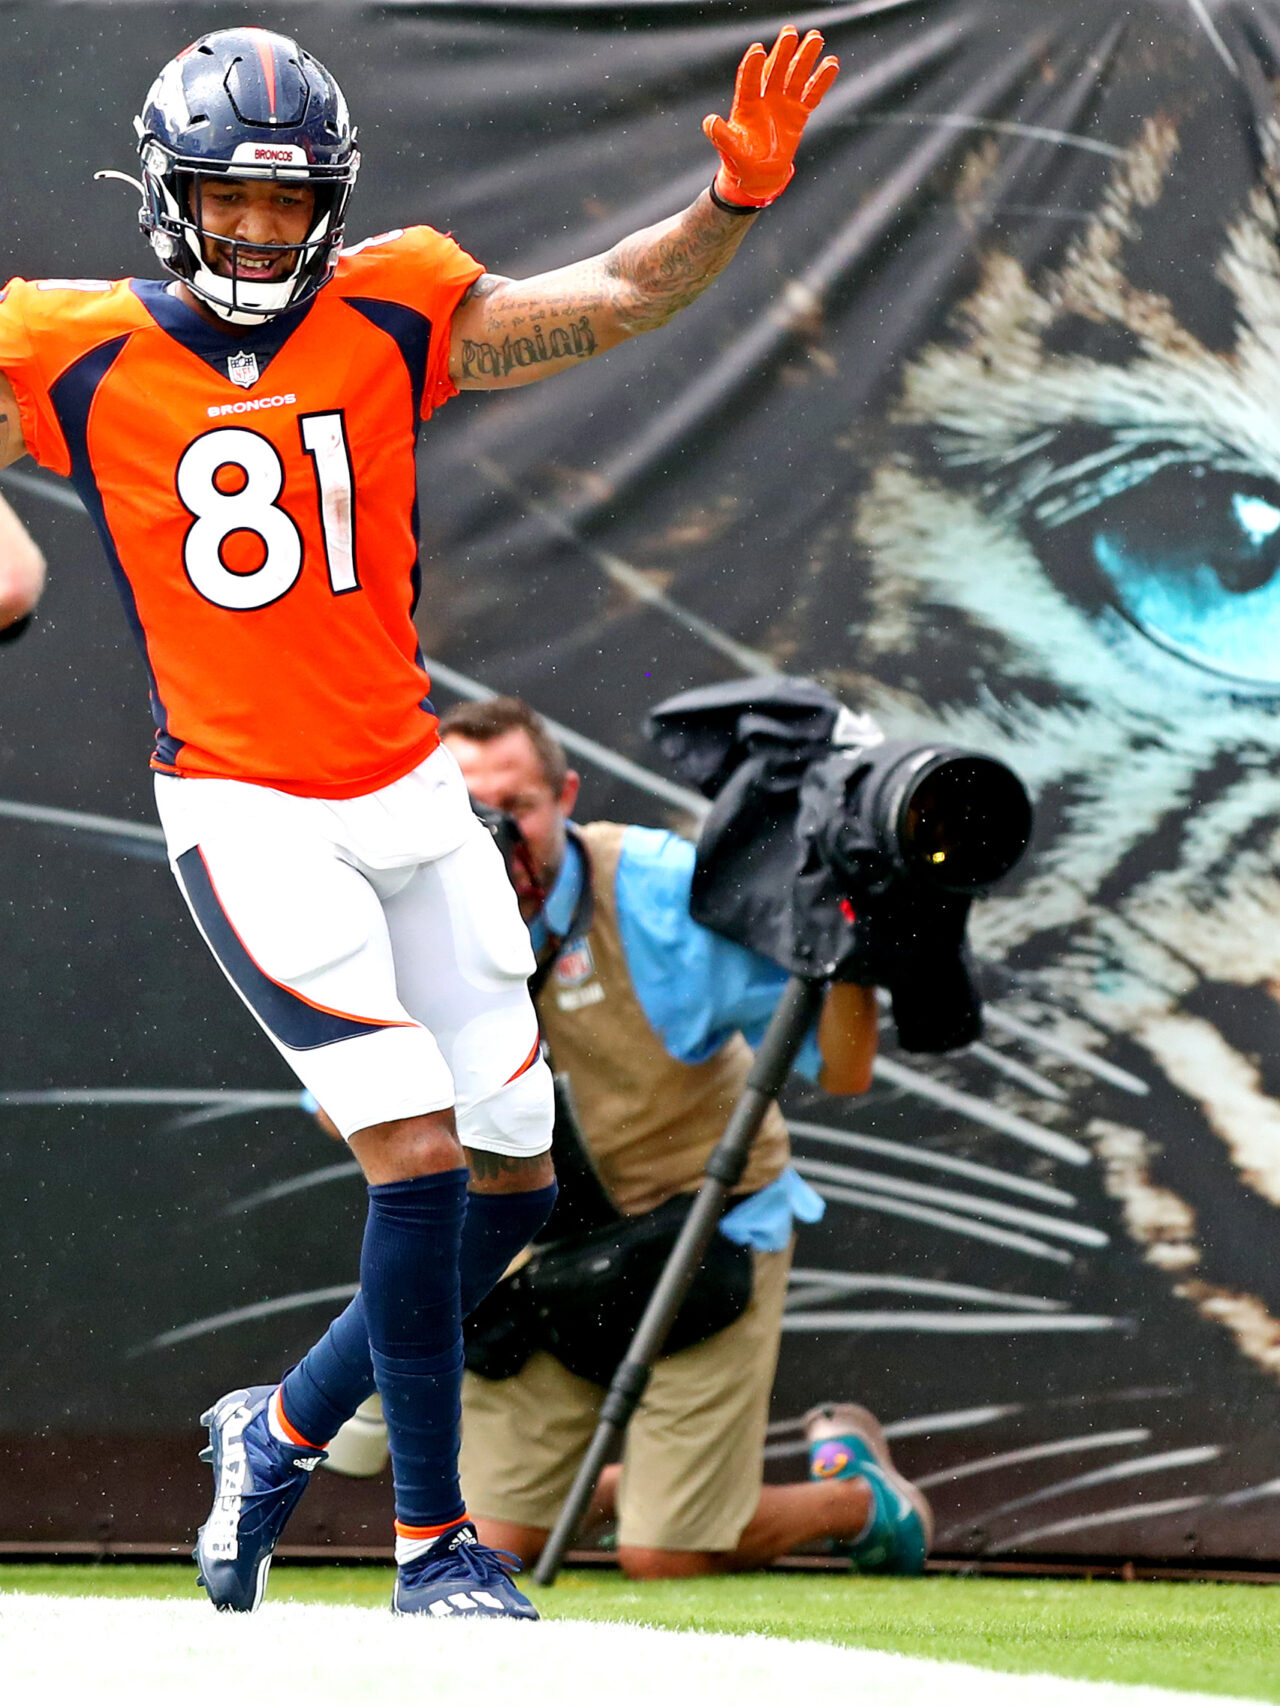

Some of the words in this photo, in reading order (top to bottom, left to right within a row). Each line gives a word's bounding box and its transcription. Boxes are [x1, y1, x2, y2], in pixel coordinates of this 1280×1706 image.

[254, 148, 293, 162] BRONCOS
[207, 393, 297, 418] BRONCOS
[175, 408, 362, 612] 81
